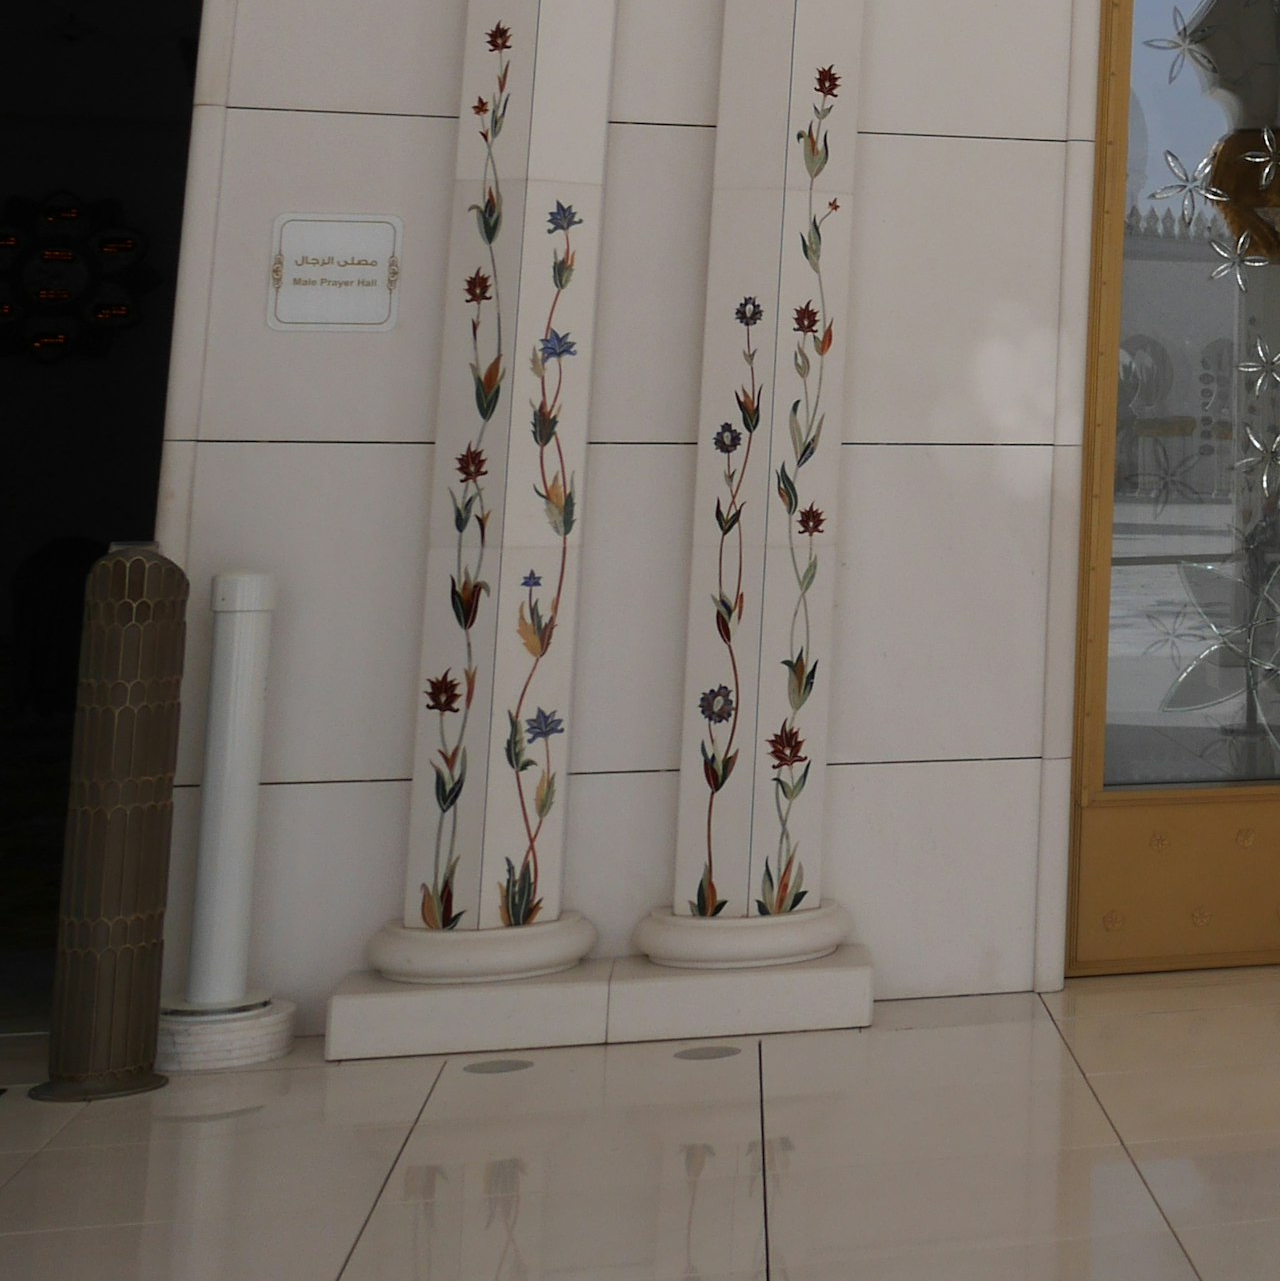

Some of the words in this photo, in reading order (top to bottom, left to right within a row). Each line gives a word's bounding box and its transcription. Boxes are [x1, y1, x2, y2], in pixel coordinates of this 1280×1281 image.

[295, 256, 334, 267] الرجال
[337, 256, 378, 267] مصلى
[293, 278, 317, 286] Male
[320, 278, 354, 288] Prayer
[357, 279, 377, 287] Hall
